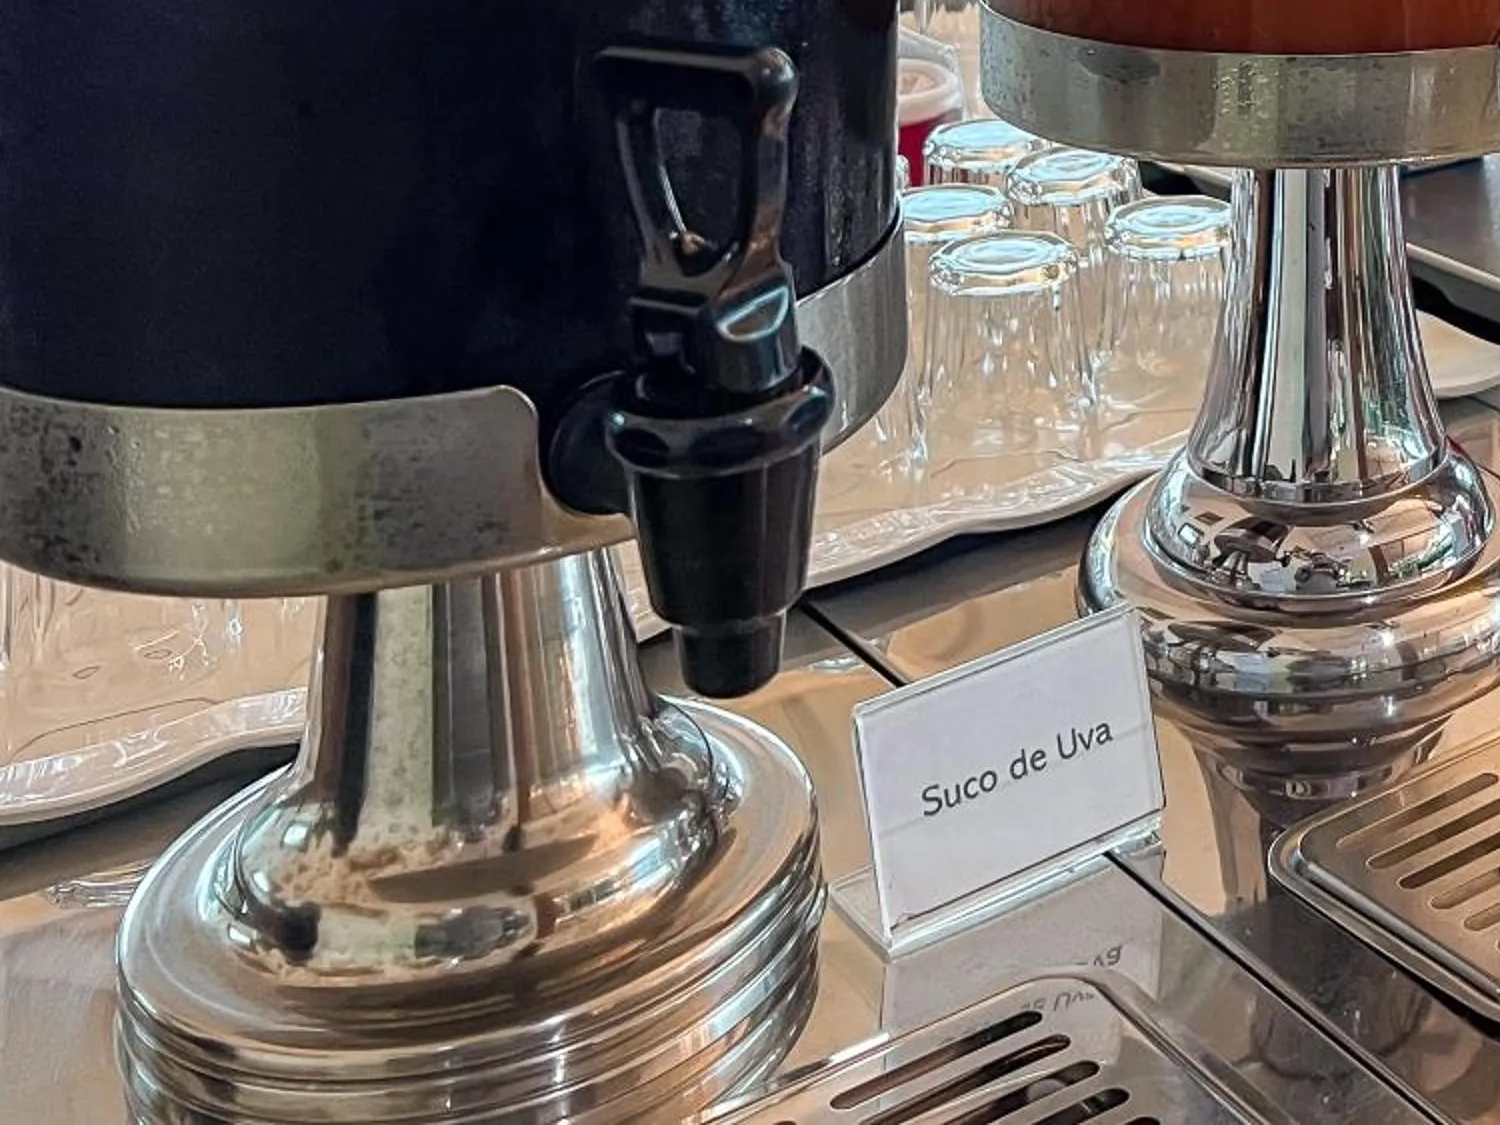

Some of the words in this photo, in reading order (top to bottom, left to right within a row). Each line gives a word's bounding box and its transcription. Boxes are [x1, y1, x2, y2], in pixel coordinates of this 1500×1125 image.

[921, 770, 998, 817] Suco
[1009, 748, 1048, 781] de
[1056, 721, 1114, 760] Uva
